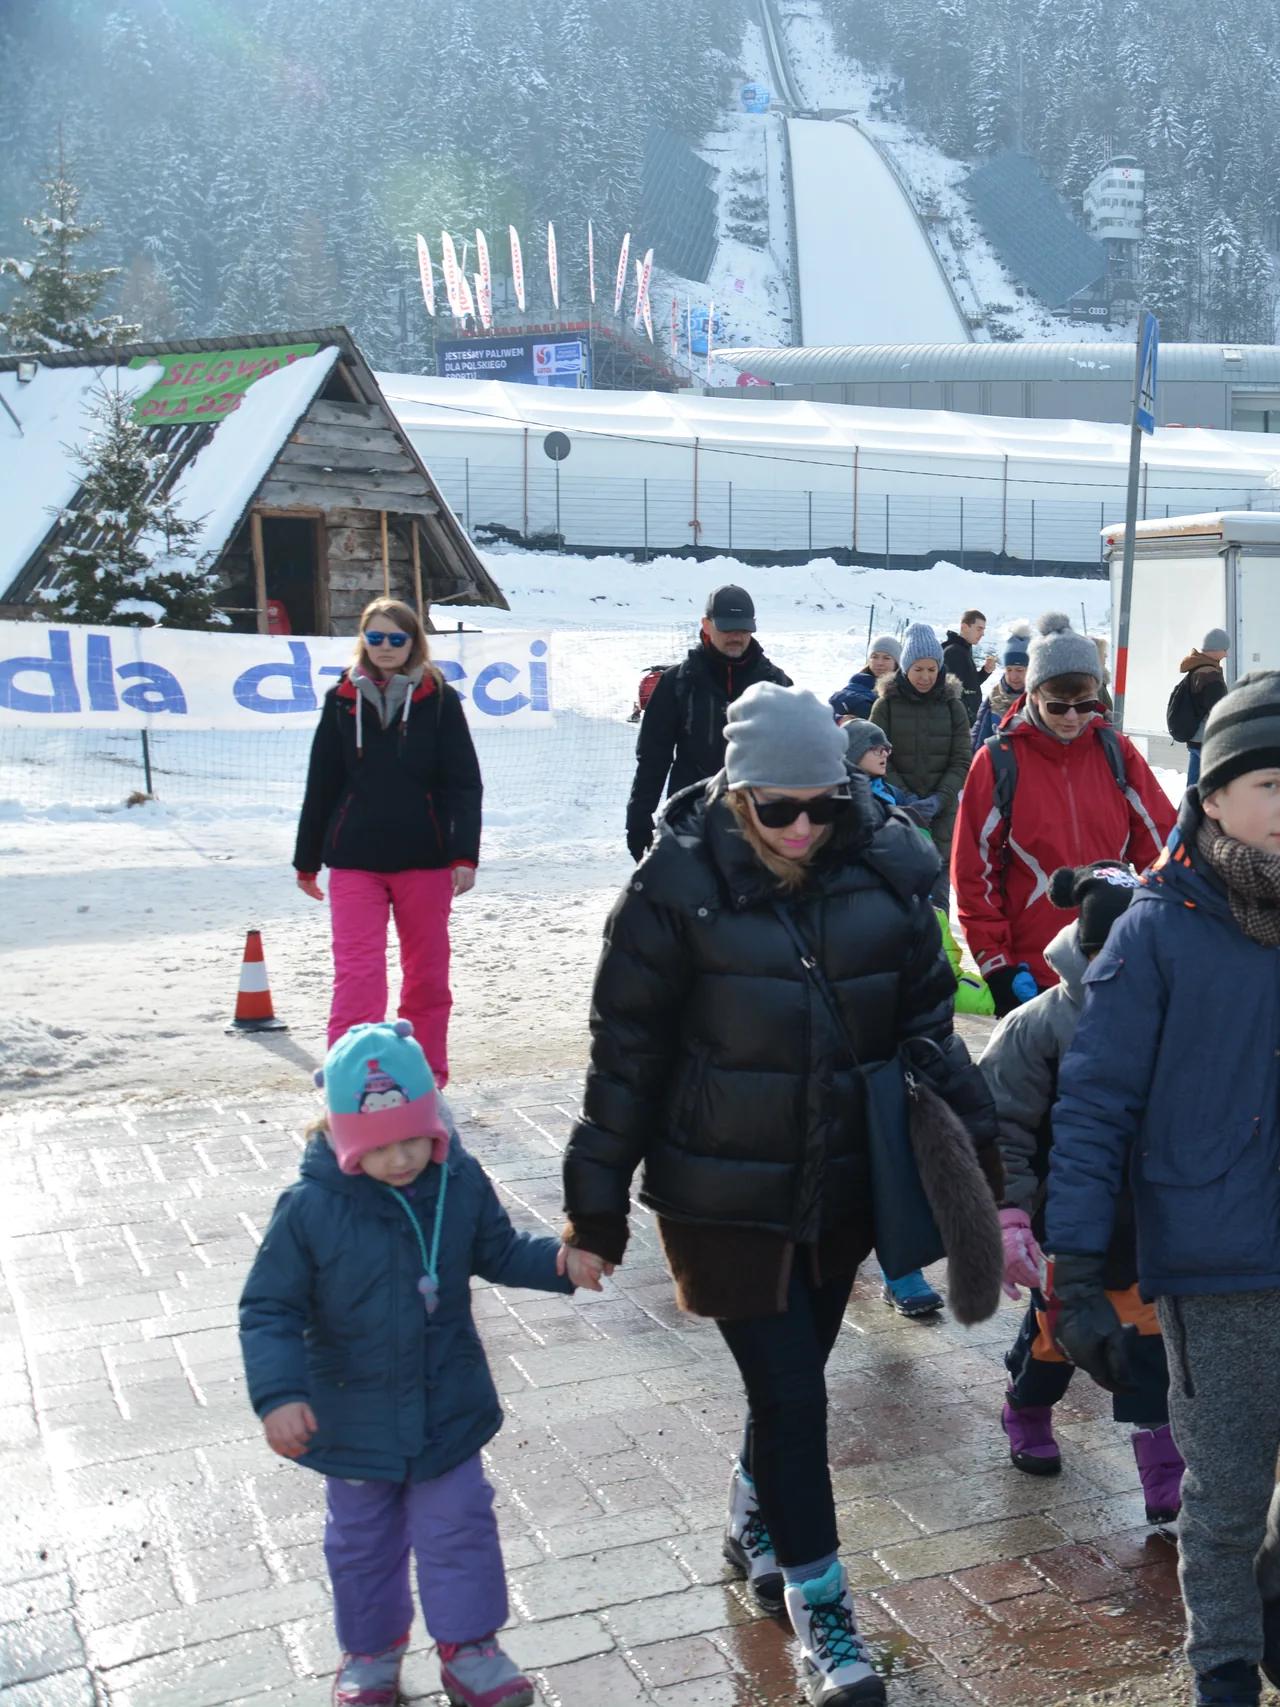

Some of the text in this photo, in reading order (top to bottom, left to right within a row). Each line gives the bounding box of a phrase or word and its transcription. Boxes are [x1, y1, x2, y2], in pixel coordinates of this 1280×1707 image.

[444, 347, 525, 361] JESTEŚMY PALIWEM
[445, 359, 508, 372] DLA POLSKIEGO
[142, 396, 188, 417] DLA
[0, 629, 187, 714] dla
